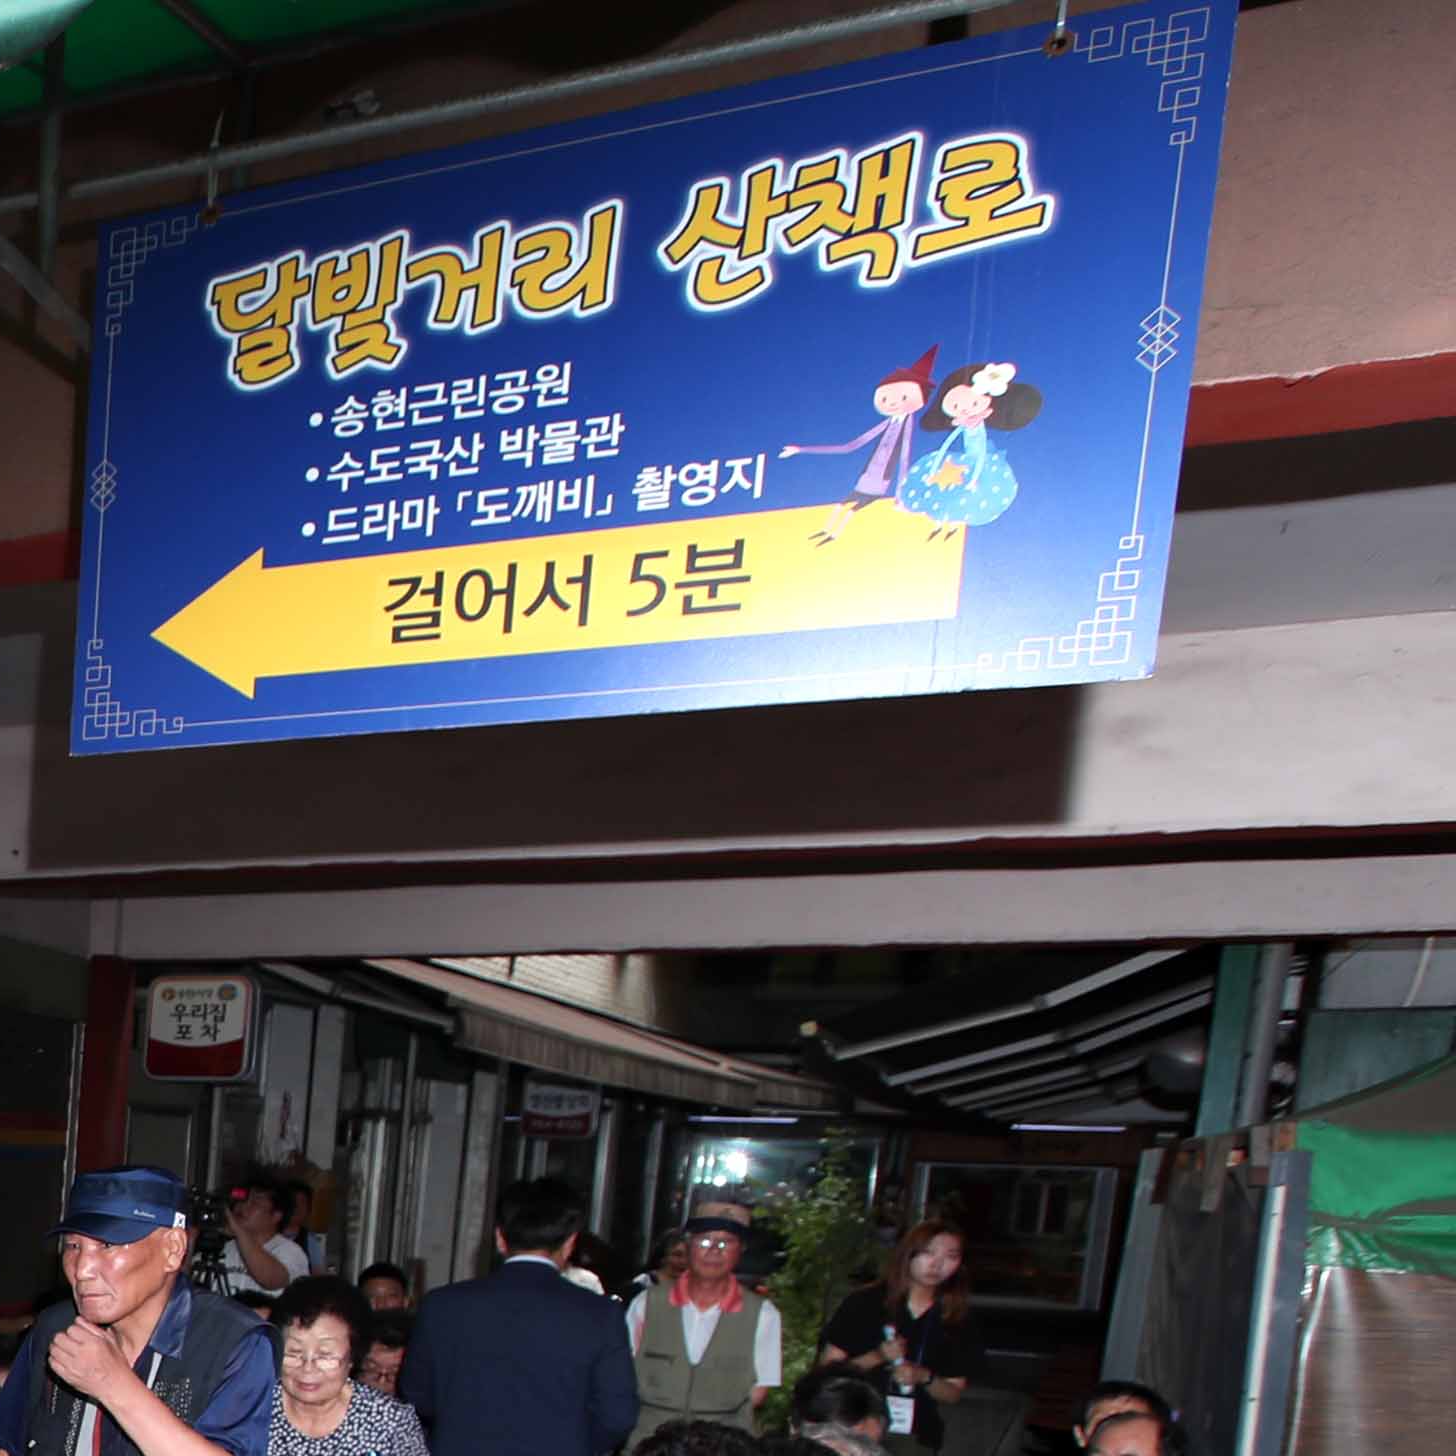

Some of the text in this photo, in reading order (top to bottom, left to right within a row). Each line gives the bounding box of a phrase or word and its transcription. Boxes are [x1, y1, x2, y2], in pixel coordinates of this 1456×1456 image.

[210, 133, 1051, 386] 달빛거리 산책로
[330, 361, 572, 437] 송현근린공원
[326, 412, 626, 491] 수도국산 박물관
[321, 495, 440, 543] 드라마
[632, 453, 766, 511] 촬영지
[382, 537, 753, 644] 걸어서 5분
[170, 1003, 226, 1022] 우리집
